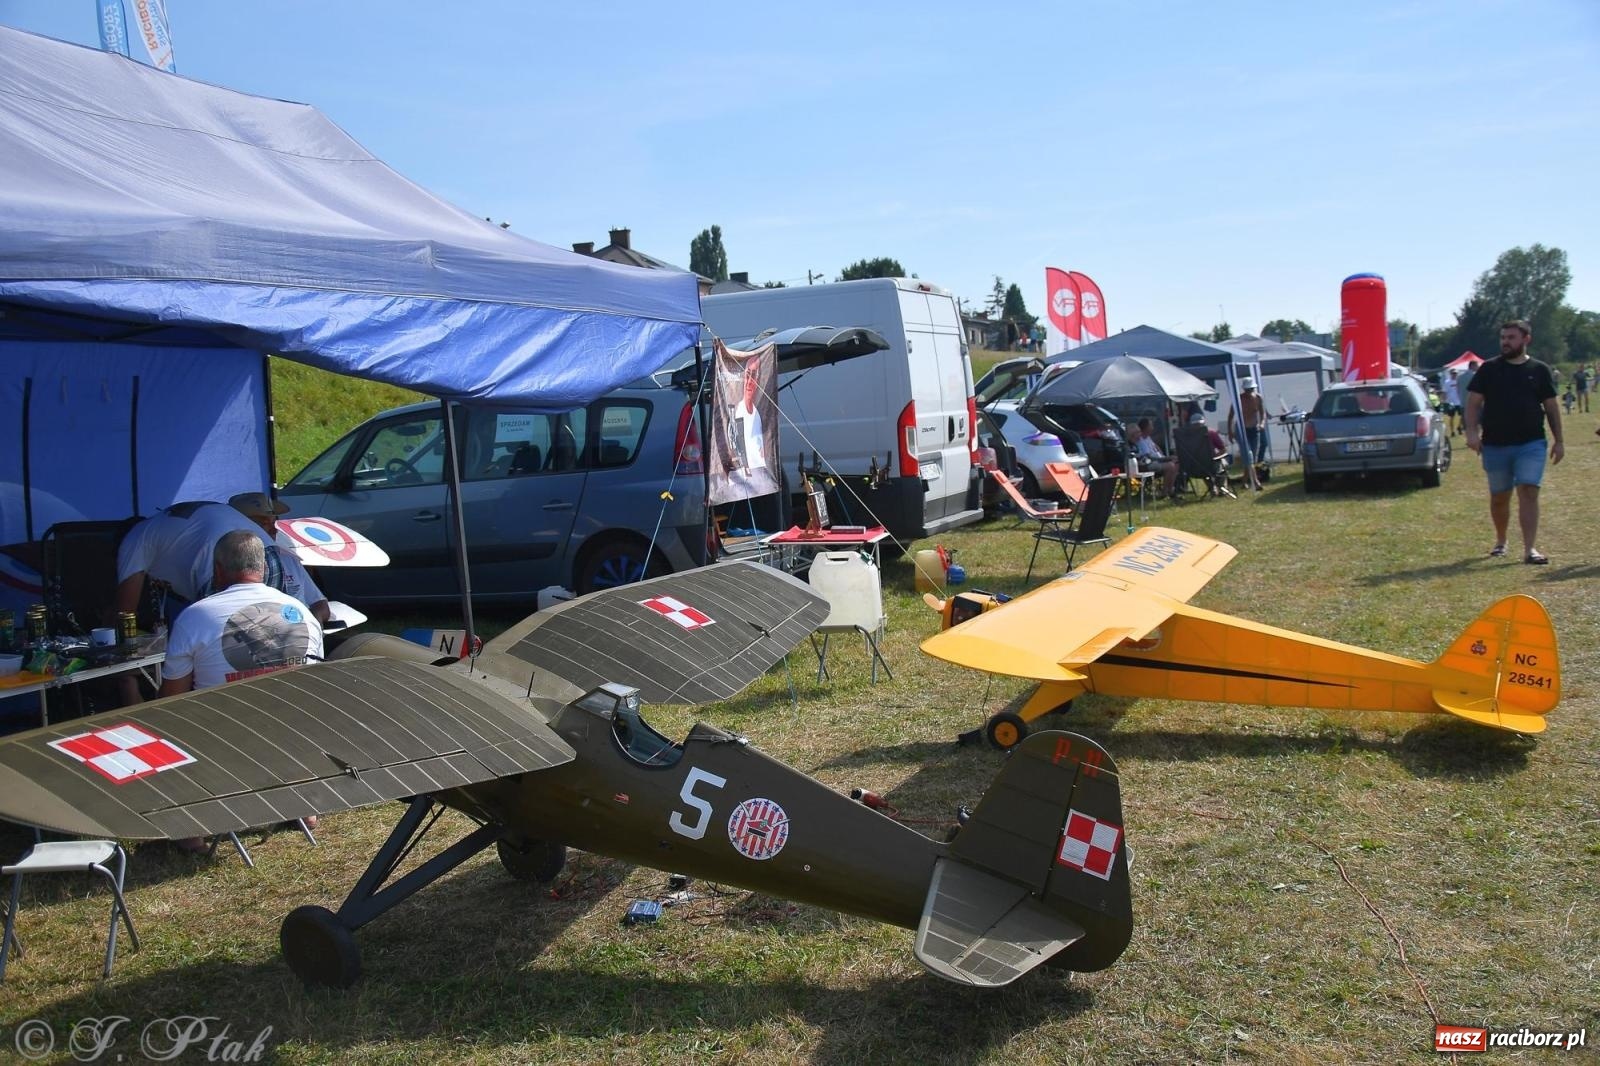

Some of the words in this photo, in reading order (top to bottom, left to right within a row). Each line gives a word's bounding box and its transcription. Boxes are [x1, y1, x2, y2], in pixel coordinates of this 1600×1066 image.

[439, 634, 455, 655] N
[1515, 653, 1537, 666] NC
[1508, 672, 1552, 689] 28541
[668, 766, 727, 840] 5
